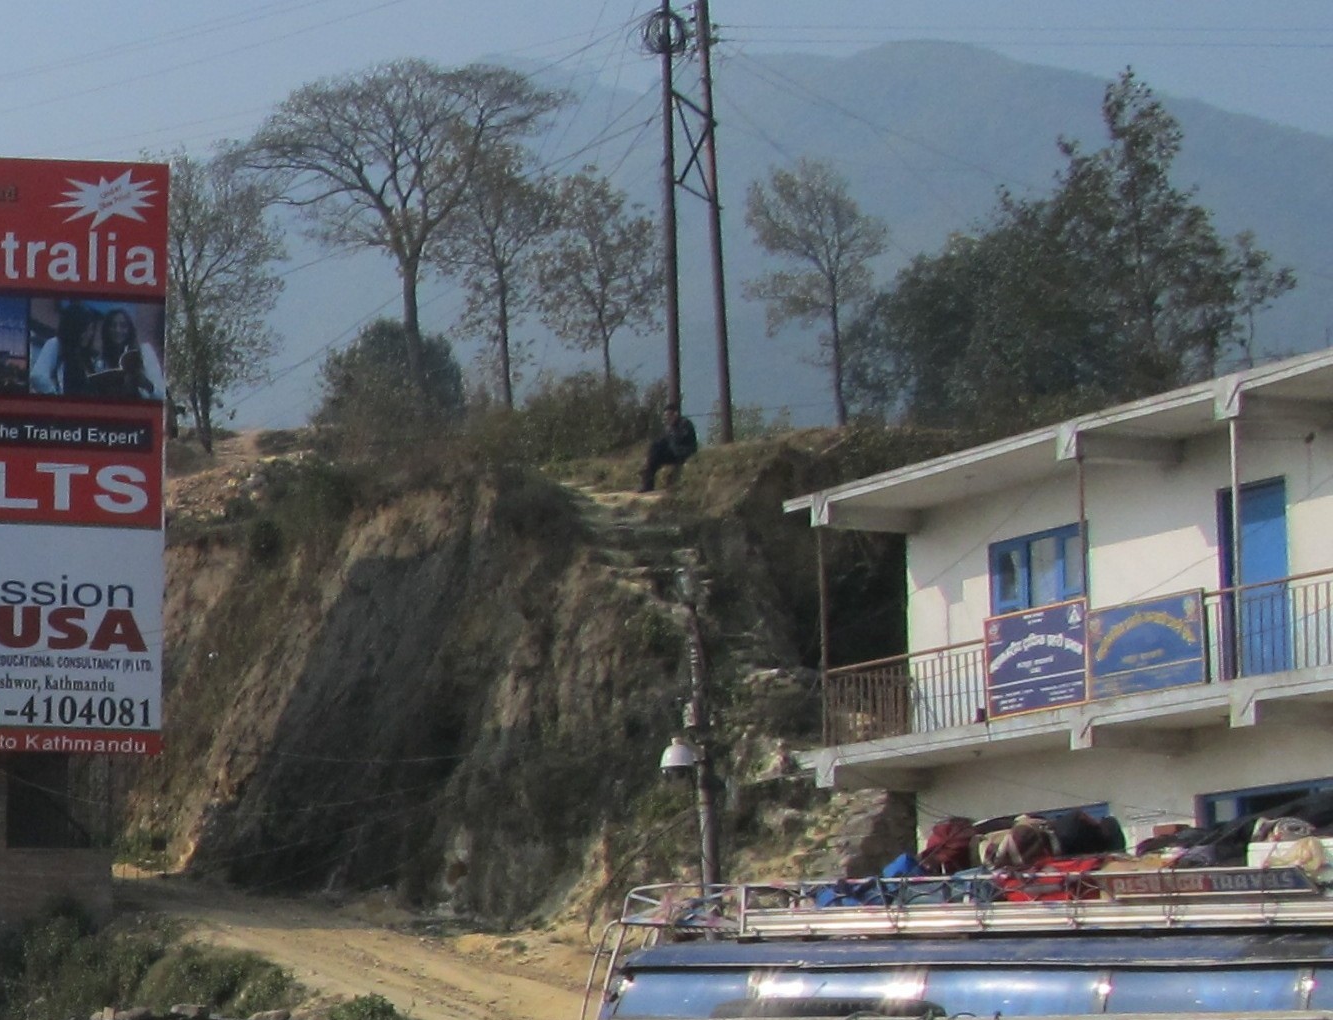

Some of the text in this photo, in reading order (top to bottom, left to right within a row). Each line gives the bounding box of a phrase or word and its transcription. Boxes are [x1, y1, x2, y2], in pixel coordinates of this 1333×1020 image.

[24, 425, 82, 441] Trained
[57, 656, 121, 670] CONSULTANCY
[45, 675, 115, 692] Kathmandu
[25, 735, 146, 754] Kathmandu
